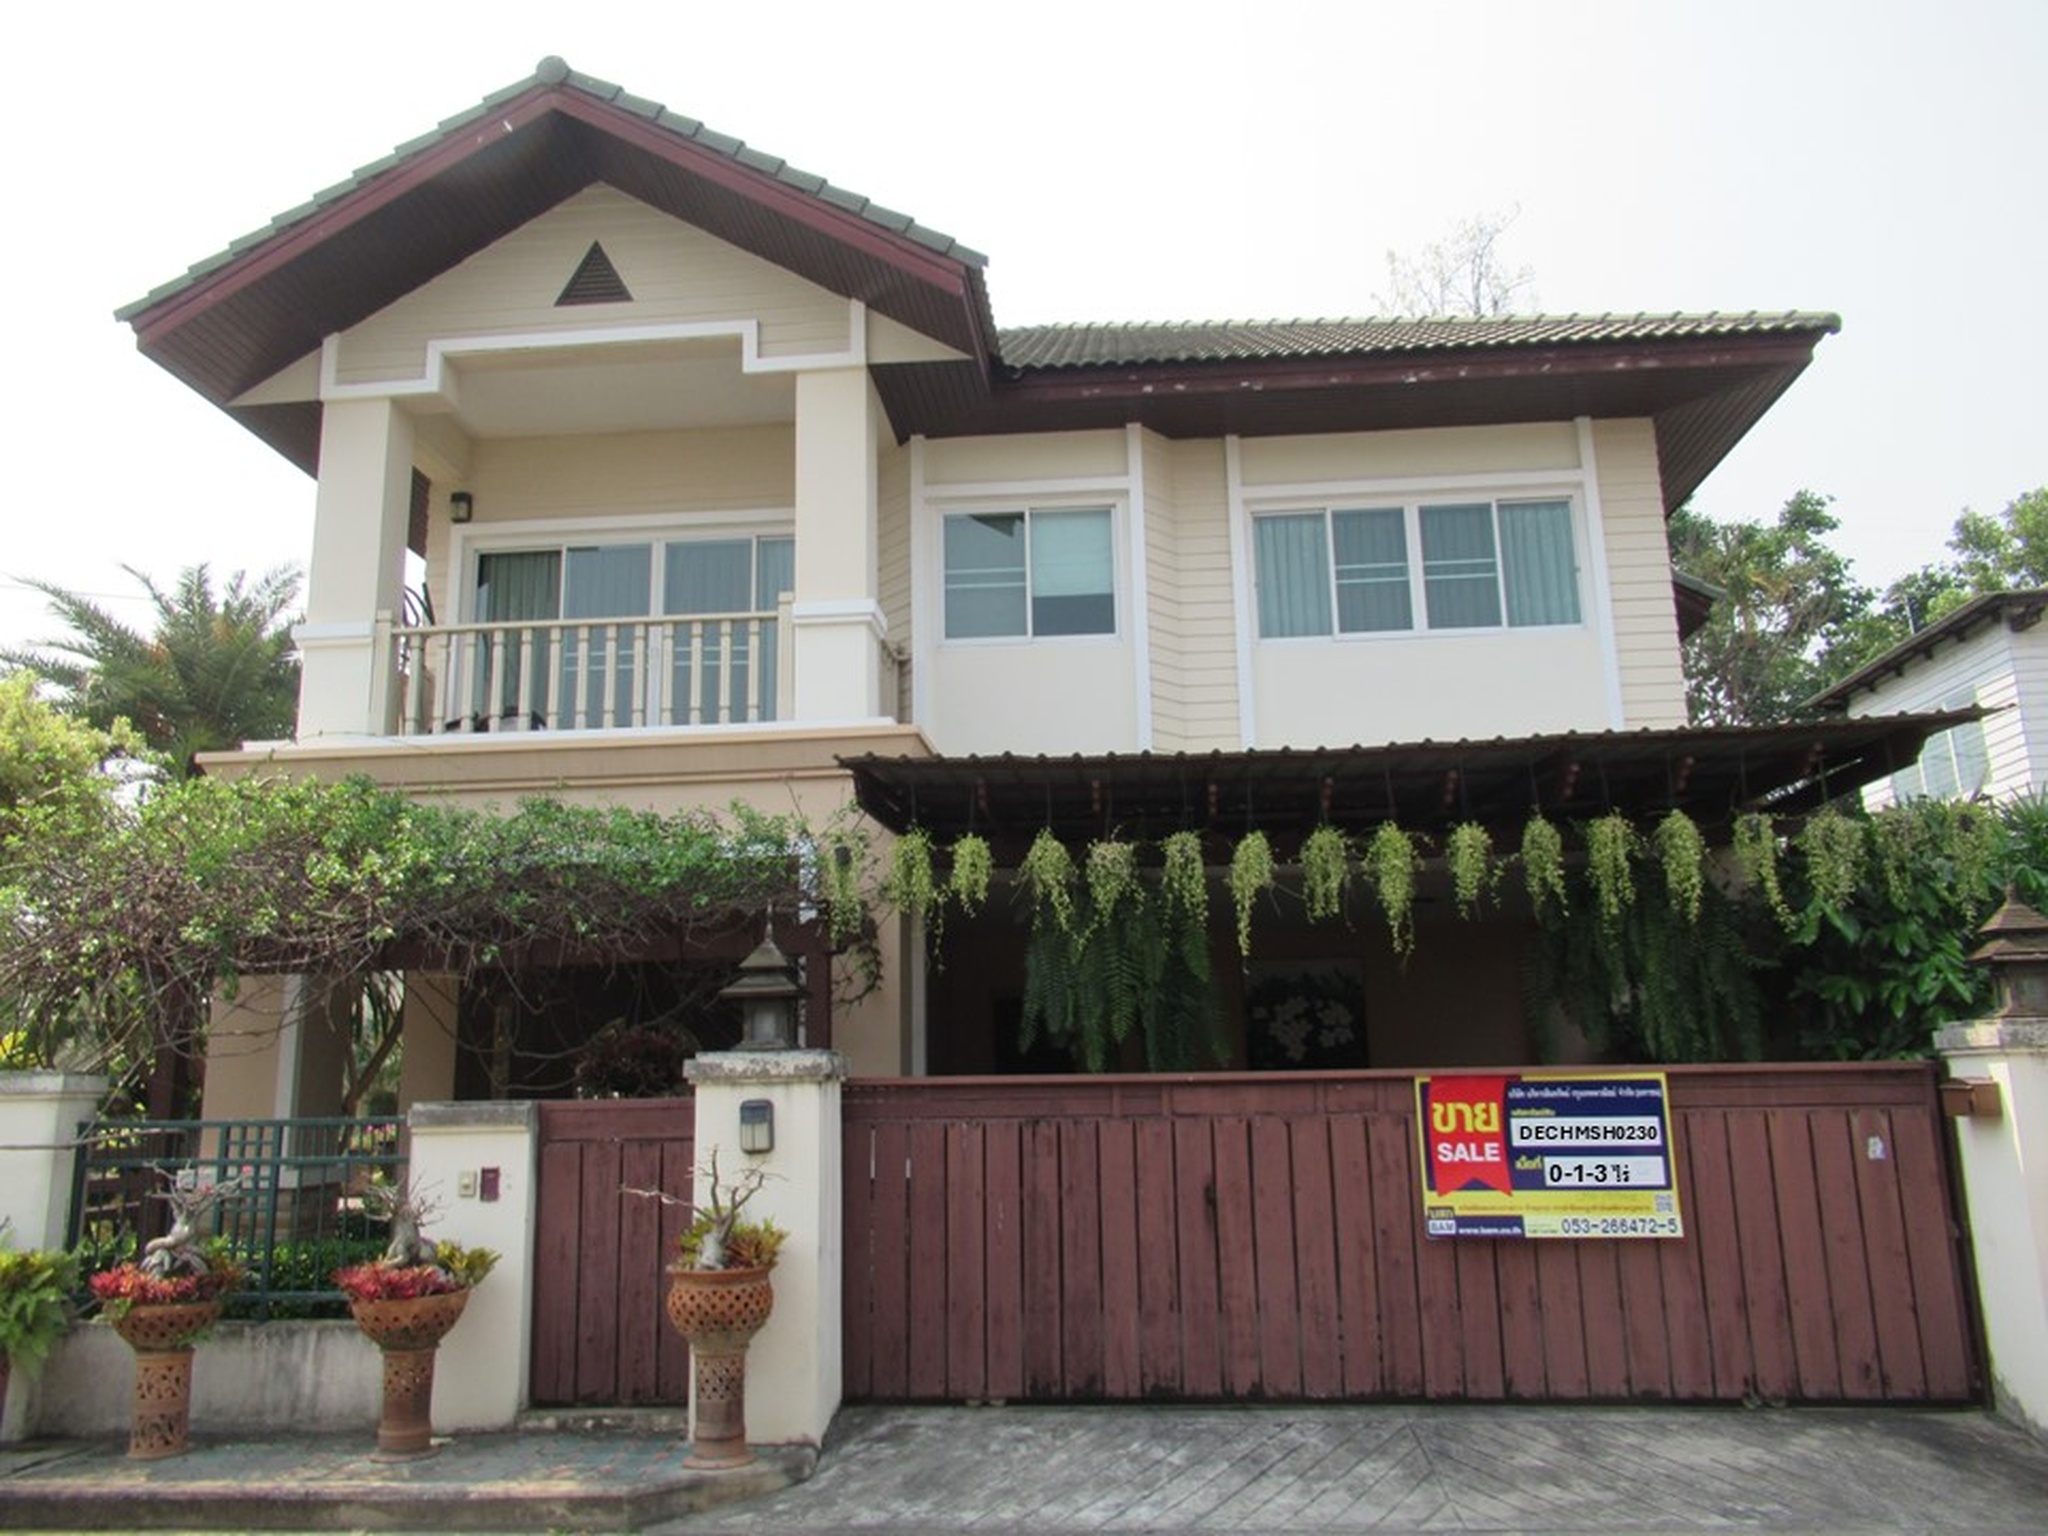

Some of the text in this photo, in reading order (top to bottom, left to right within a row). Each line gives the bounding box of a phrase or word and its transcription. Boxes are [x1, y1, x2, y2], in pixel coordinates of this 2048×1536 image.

[1432, 1102, 1500, 1133] ขาย
[1519, 1125, 1658, 1140] DECHMSH0230
[1437, 1142, 1501, 1162] SALE
[1549, 1164, 1608, 1183] 0-1-3
[1561, 1217, 1678, 1235] 053-266472-5
